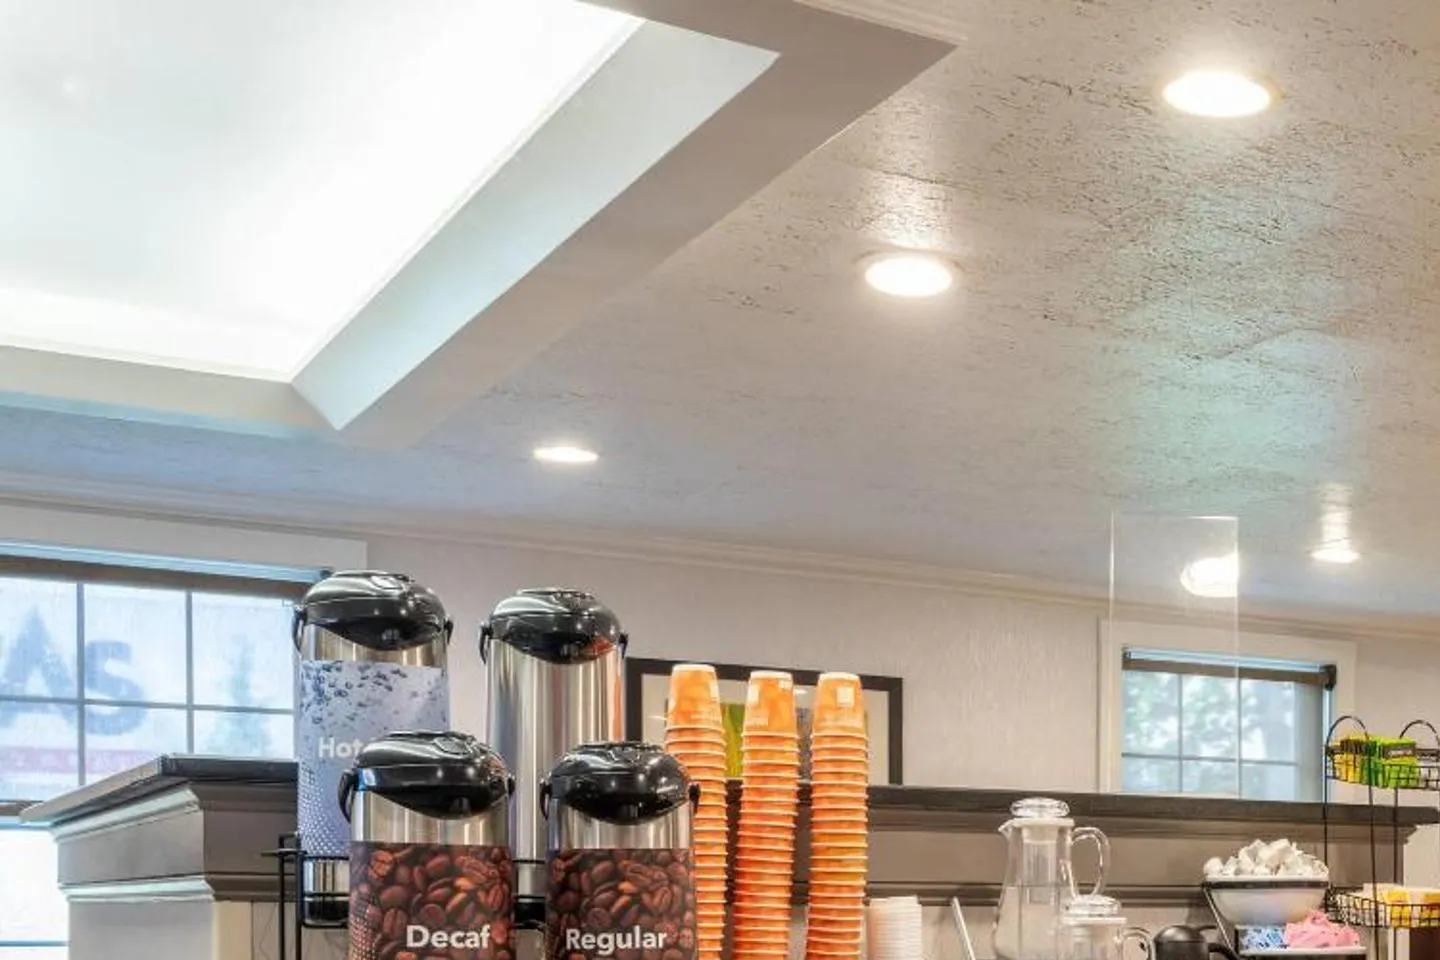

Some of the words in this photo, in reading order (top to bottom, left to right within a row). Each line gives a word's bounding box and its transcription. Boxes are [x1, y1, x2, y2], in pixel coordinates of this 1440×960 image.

[318, 736, 362, 758] Hot
[406, 924, 491, 949] Decaf
[565, 925, 668, 955] Regular
